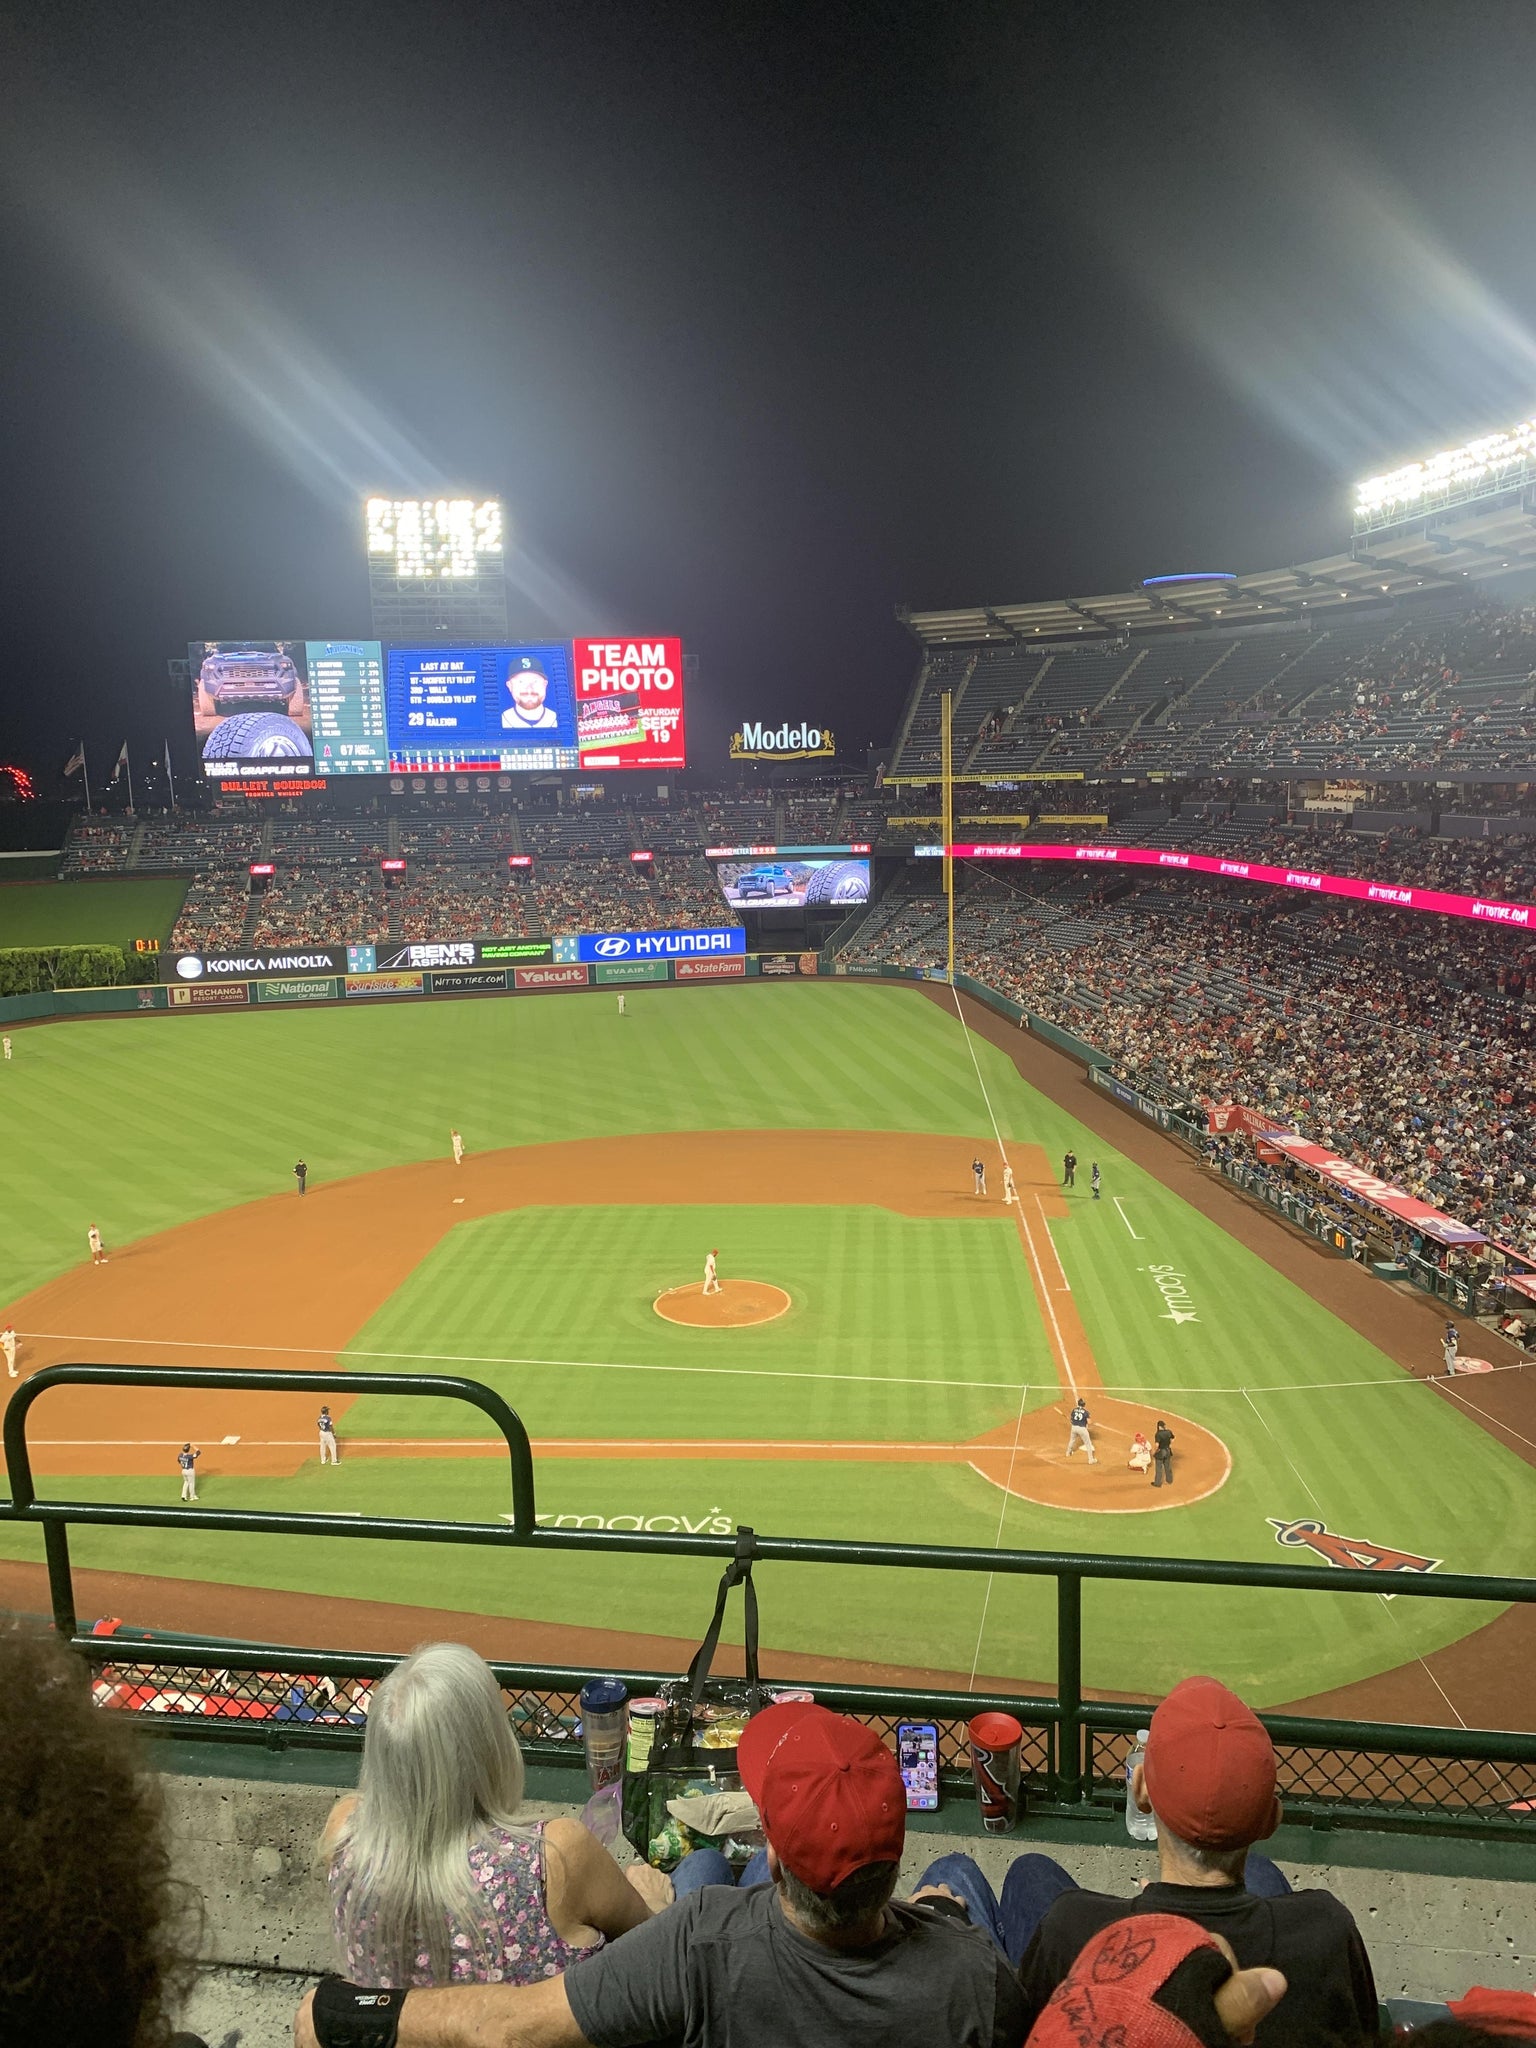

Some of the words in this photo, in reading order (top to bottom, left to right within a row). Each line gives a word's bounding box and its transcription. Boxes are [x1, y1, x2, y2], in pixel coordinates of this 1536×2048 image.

[588, 644, 666, 667] TEAM
[421, 662, 439, 671] LAST
[440, 662, 449, 670] AT
[451, 662, 464, 670] BAT
[582, 668, 675, 691] PHOTO
[429, 686, 448, 694] WALK
[462, 695, 477, 703] LEFT
[638, 708, 680, 716] SATURDAY
[408, 712, 424, 726] 29
[640, 716, 679, 730] SEPT
[652, 730, 670, 743] 19
[742, 722, 821, 750] Modelo
[340, 744, 353, 755] 67
[205, 767, 239, 776] TERRA
[240, 766, 295, 775] GRAPPLER
[273, 780, 327, 790] BOURBON
[1368, 884, 1412, 904] NITTOTIRE.COM
[1472, 902, 1529, 923] NITTOTIRE.COM
[636, 933, 731, 953] HYUNDAI
[365, 949, 371, 957] 3
[410, 943, 475, 959] BEN'S
[555, 953, 563, 962] P
[207, 958, 265, 973] KONICA
[268, 955, 333, 969] MINOLTA
[366, 963, 372, 972] 7
[411, 955, 475, 967] ASPHALT
[520, 970, 584, 983] Yakult
[192, 987, 243, 996] PECHANGA
[279, 981, 330, 994] National
[350, 979, 394, 992] Surfside
[1313, 1160, 1409, 1200] 2026
